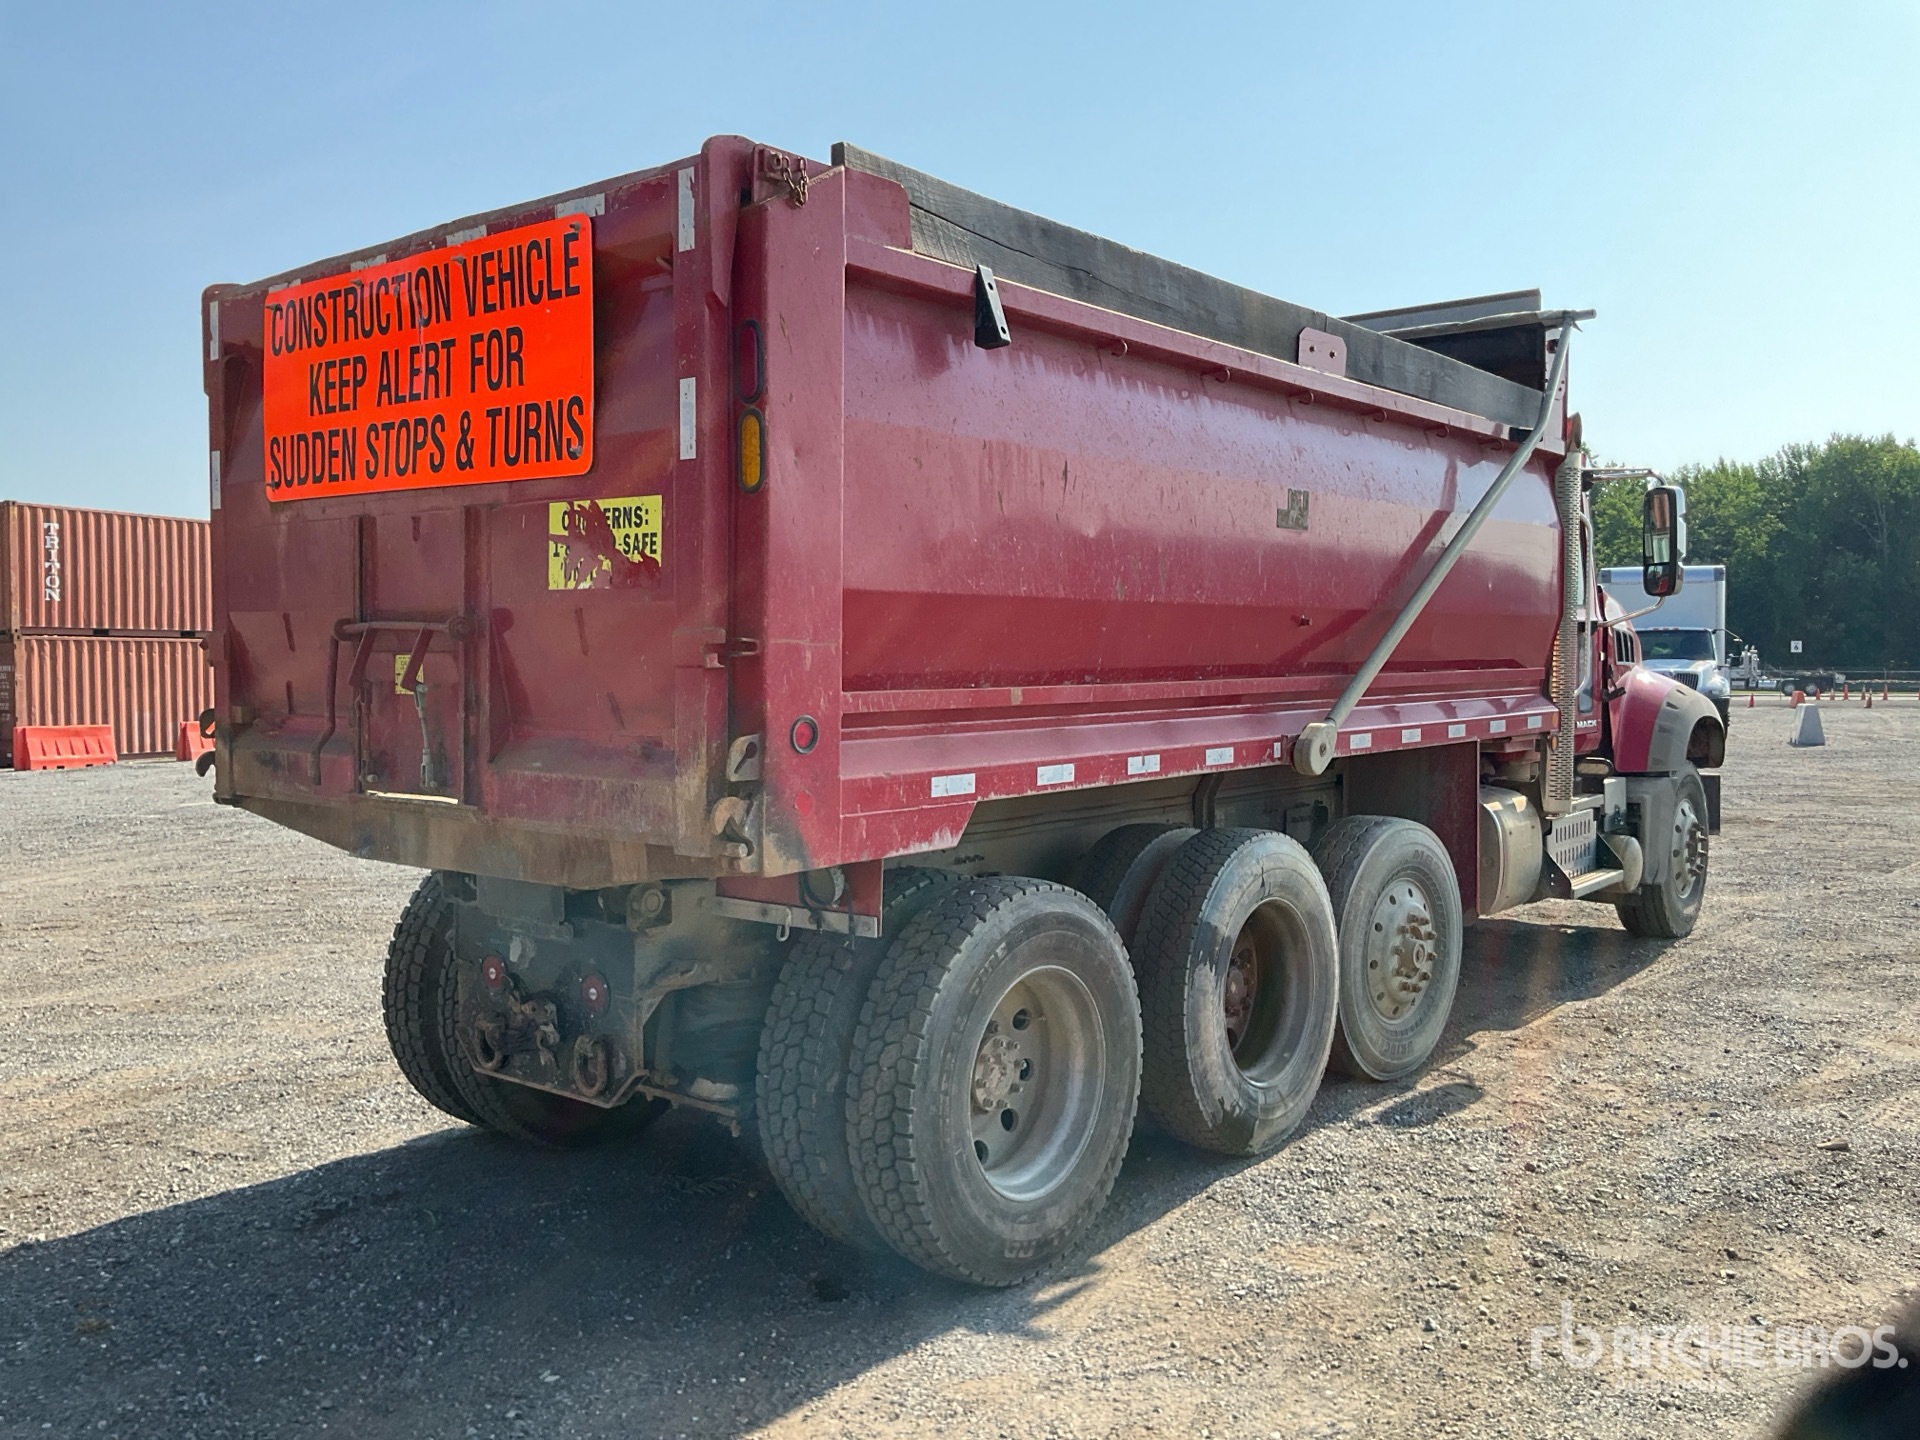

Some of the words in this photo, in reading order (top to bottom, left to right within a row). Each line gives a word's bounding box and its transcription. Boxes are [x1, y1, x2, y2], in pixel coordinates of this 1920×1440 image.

[271, 262, 451, 356] CONSTRUCTION
[462, 232, 581, 317] VEHICLE
[309, 355, 367, 417] KEEP
[376, 338, 456, 406] ALERT
[470, 326, 525, 393] FOR
[270, 426, 356, 489] SUDDEN
[366, 414, 446, 478] STOPS
[455, 410, 474, 470] &
[485, 396, 585, 467] TURNS
[44, 522, 61, 602] TRITON
